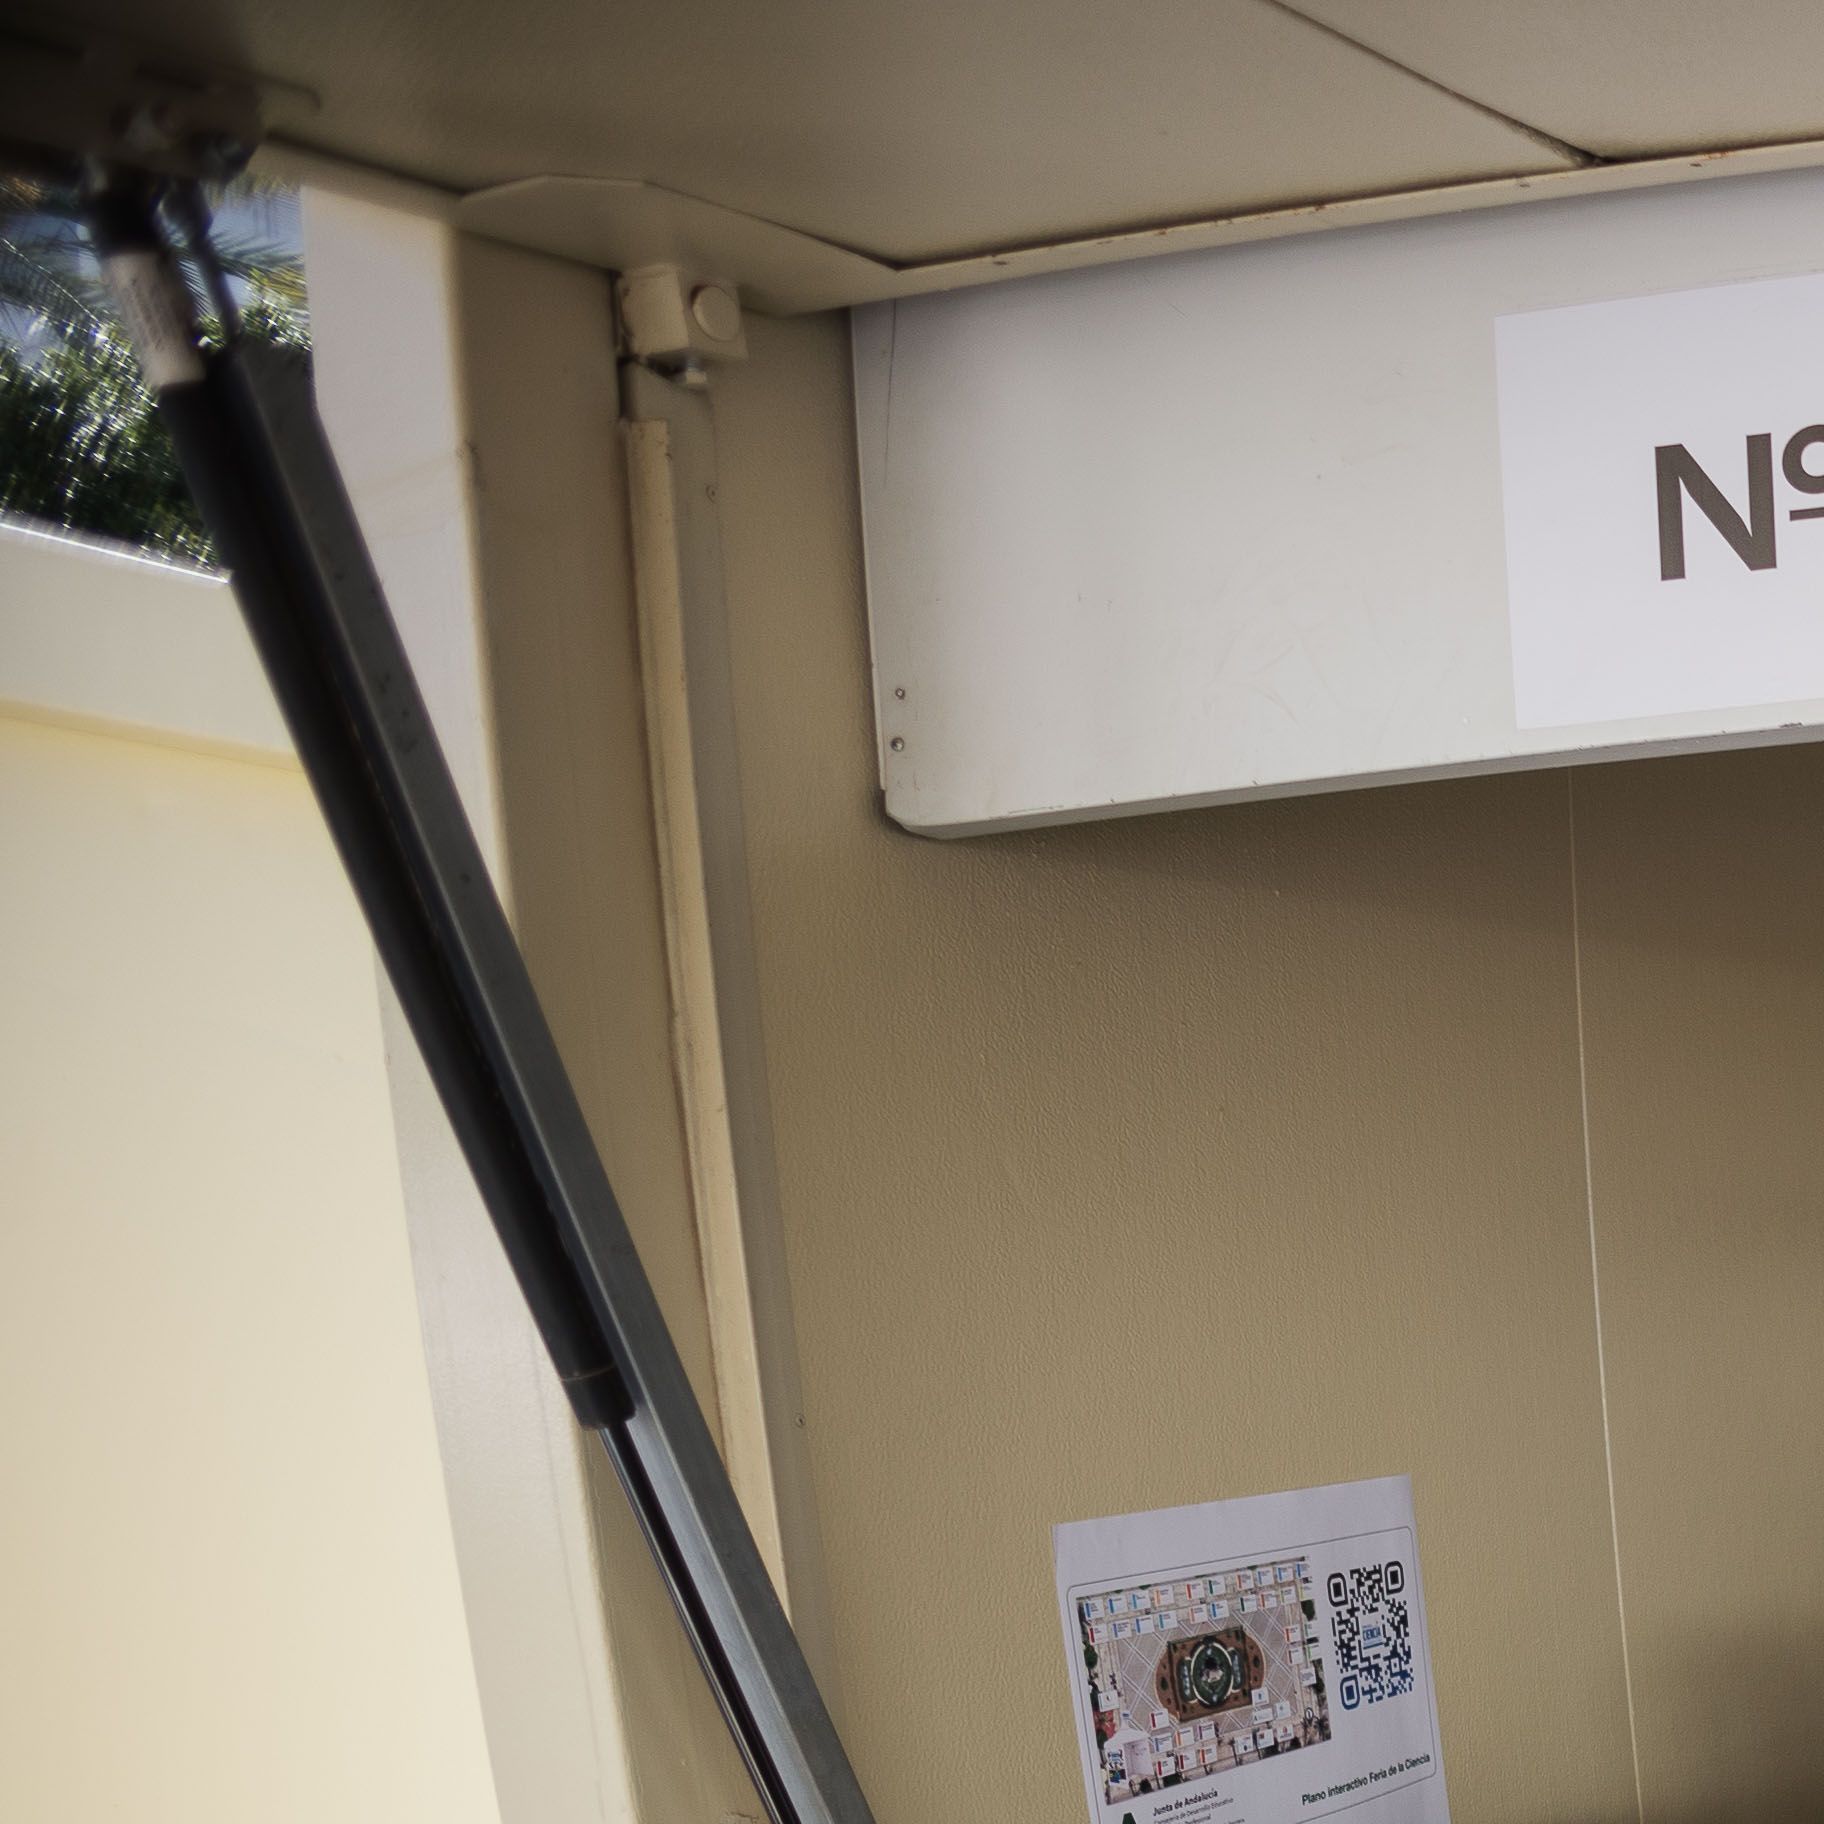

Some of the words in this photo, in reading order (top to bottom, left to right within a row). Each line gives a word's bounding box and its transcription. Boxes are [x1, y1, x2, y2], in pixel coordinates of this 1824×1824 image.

[1301, 1790, 1326, 1806] Plano
[1327, 1776, 1368, 1797] interactivo
[1369, 1769, 1387, 1783] Feria
[1388, 1765, 1397, 1776] de
[1398, 1761, 1404, 1772] la
[1405, 1753, 1431, 1770] Ciencia
